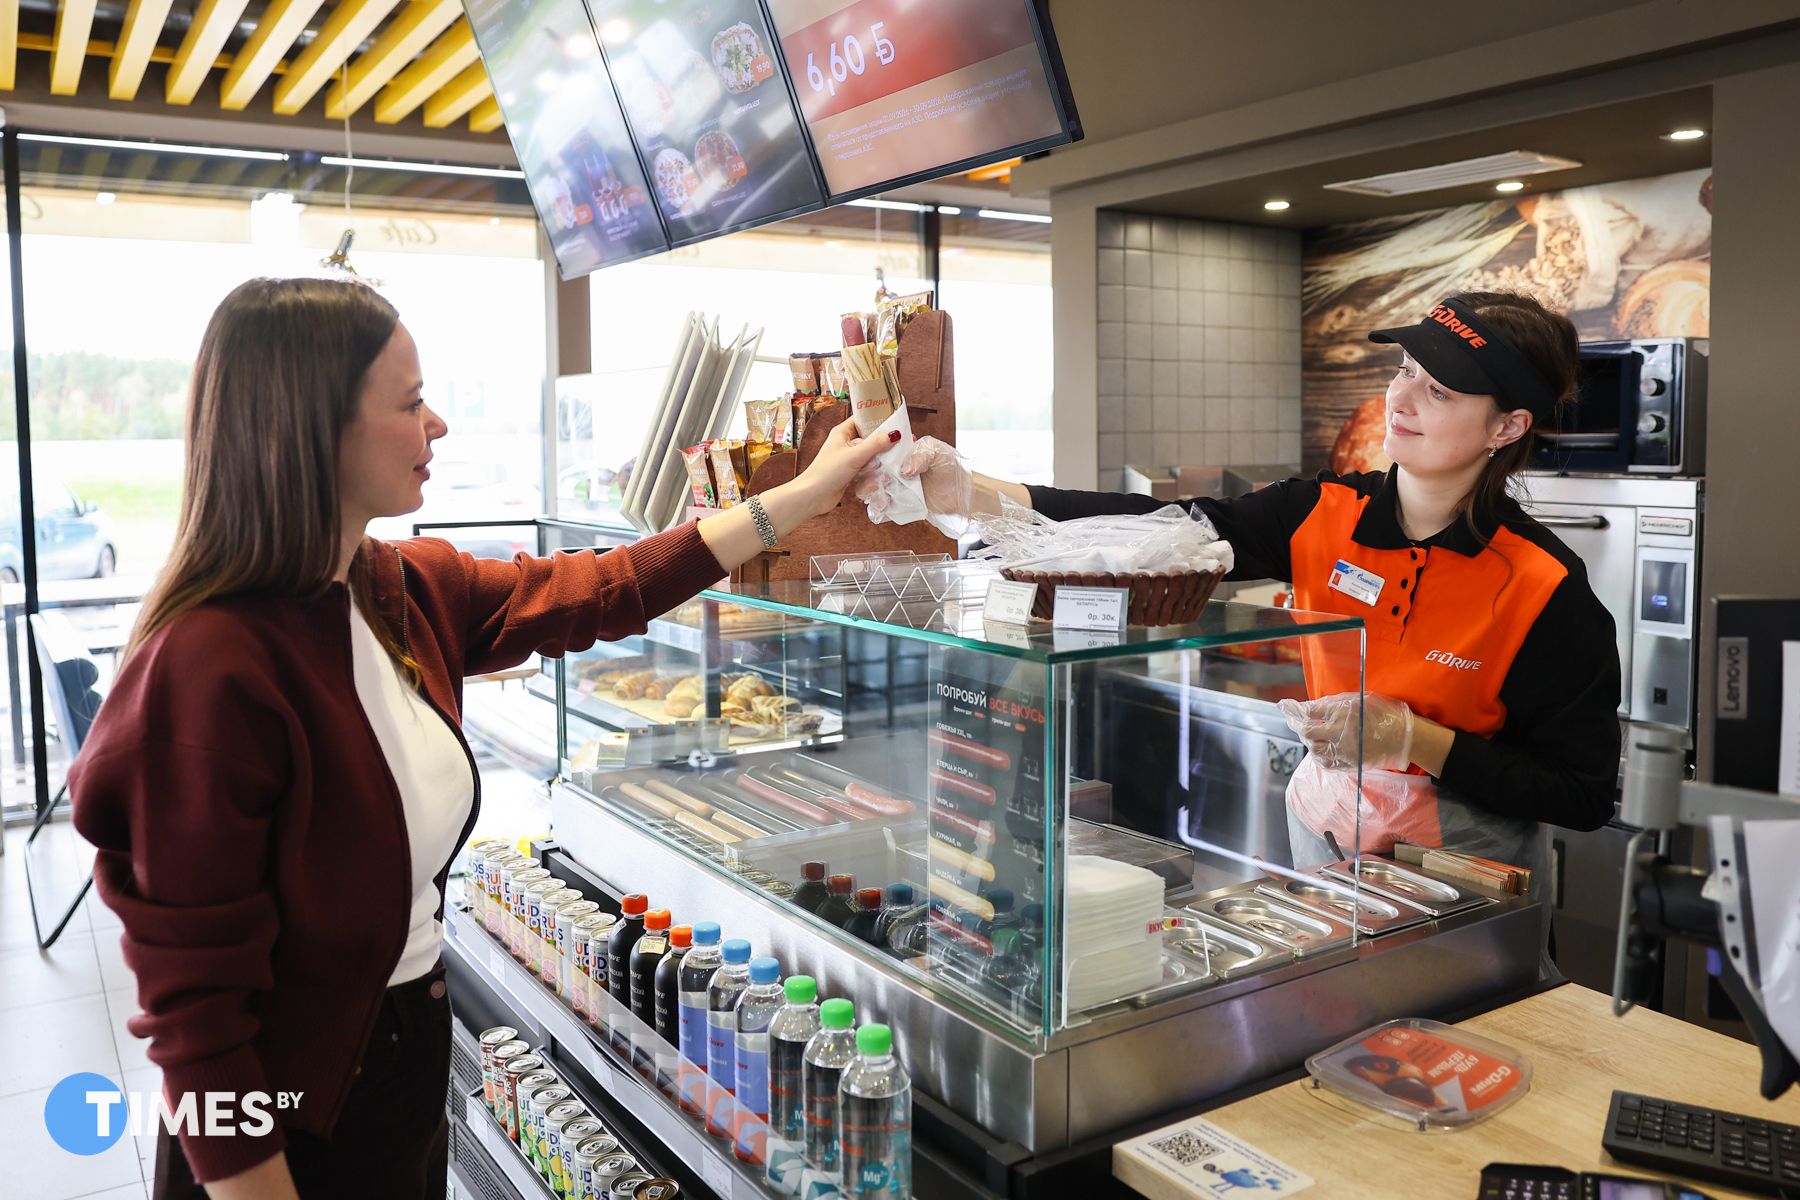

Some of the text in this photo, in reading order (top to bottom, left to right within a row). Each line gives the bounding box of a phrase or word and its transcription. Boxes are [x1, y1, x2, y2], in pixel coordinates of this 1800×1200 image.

[807, 35, 865, 96] 6,60
[936, 683, 987, 708] ПОПРОБУЙ
[989, 697, 1008, 714] ВСЕ
[1723, 645, 1740, 712] Lenovo
